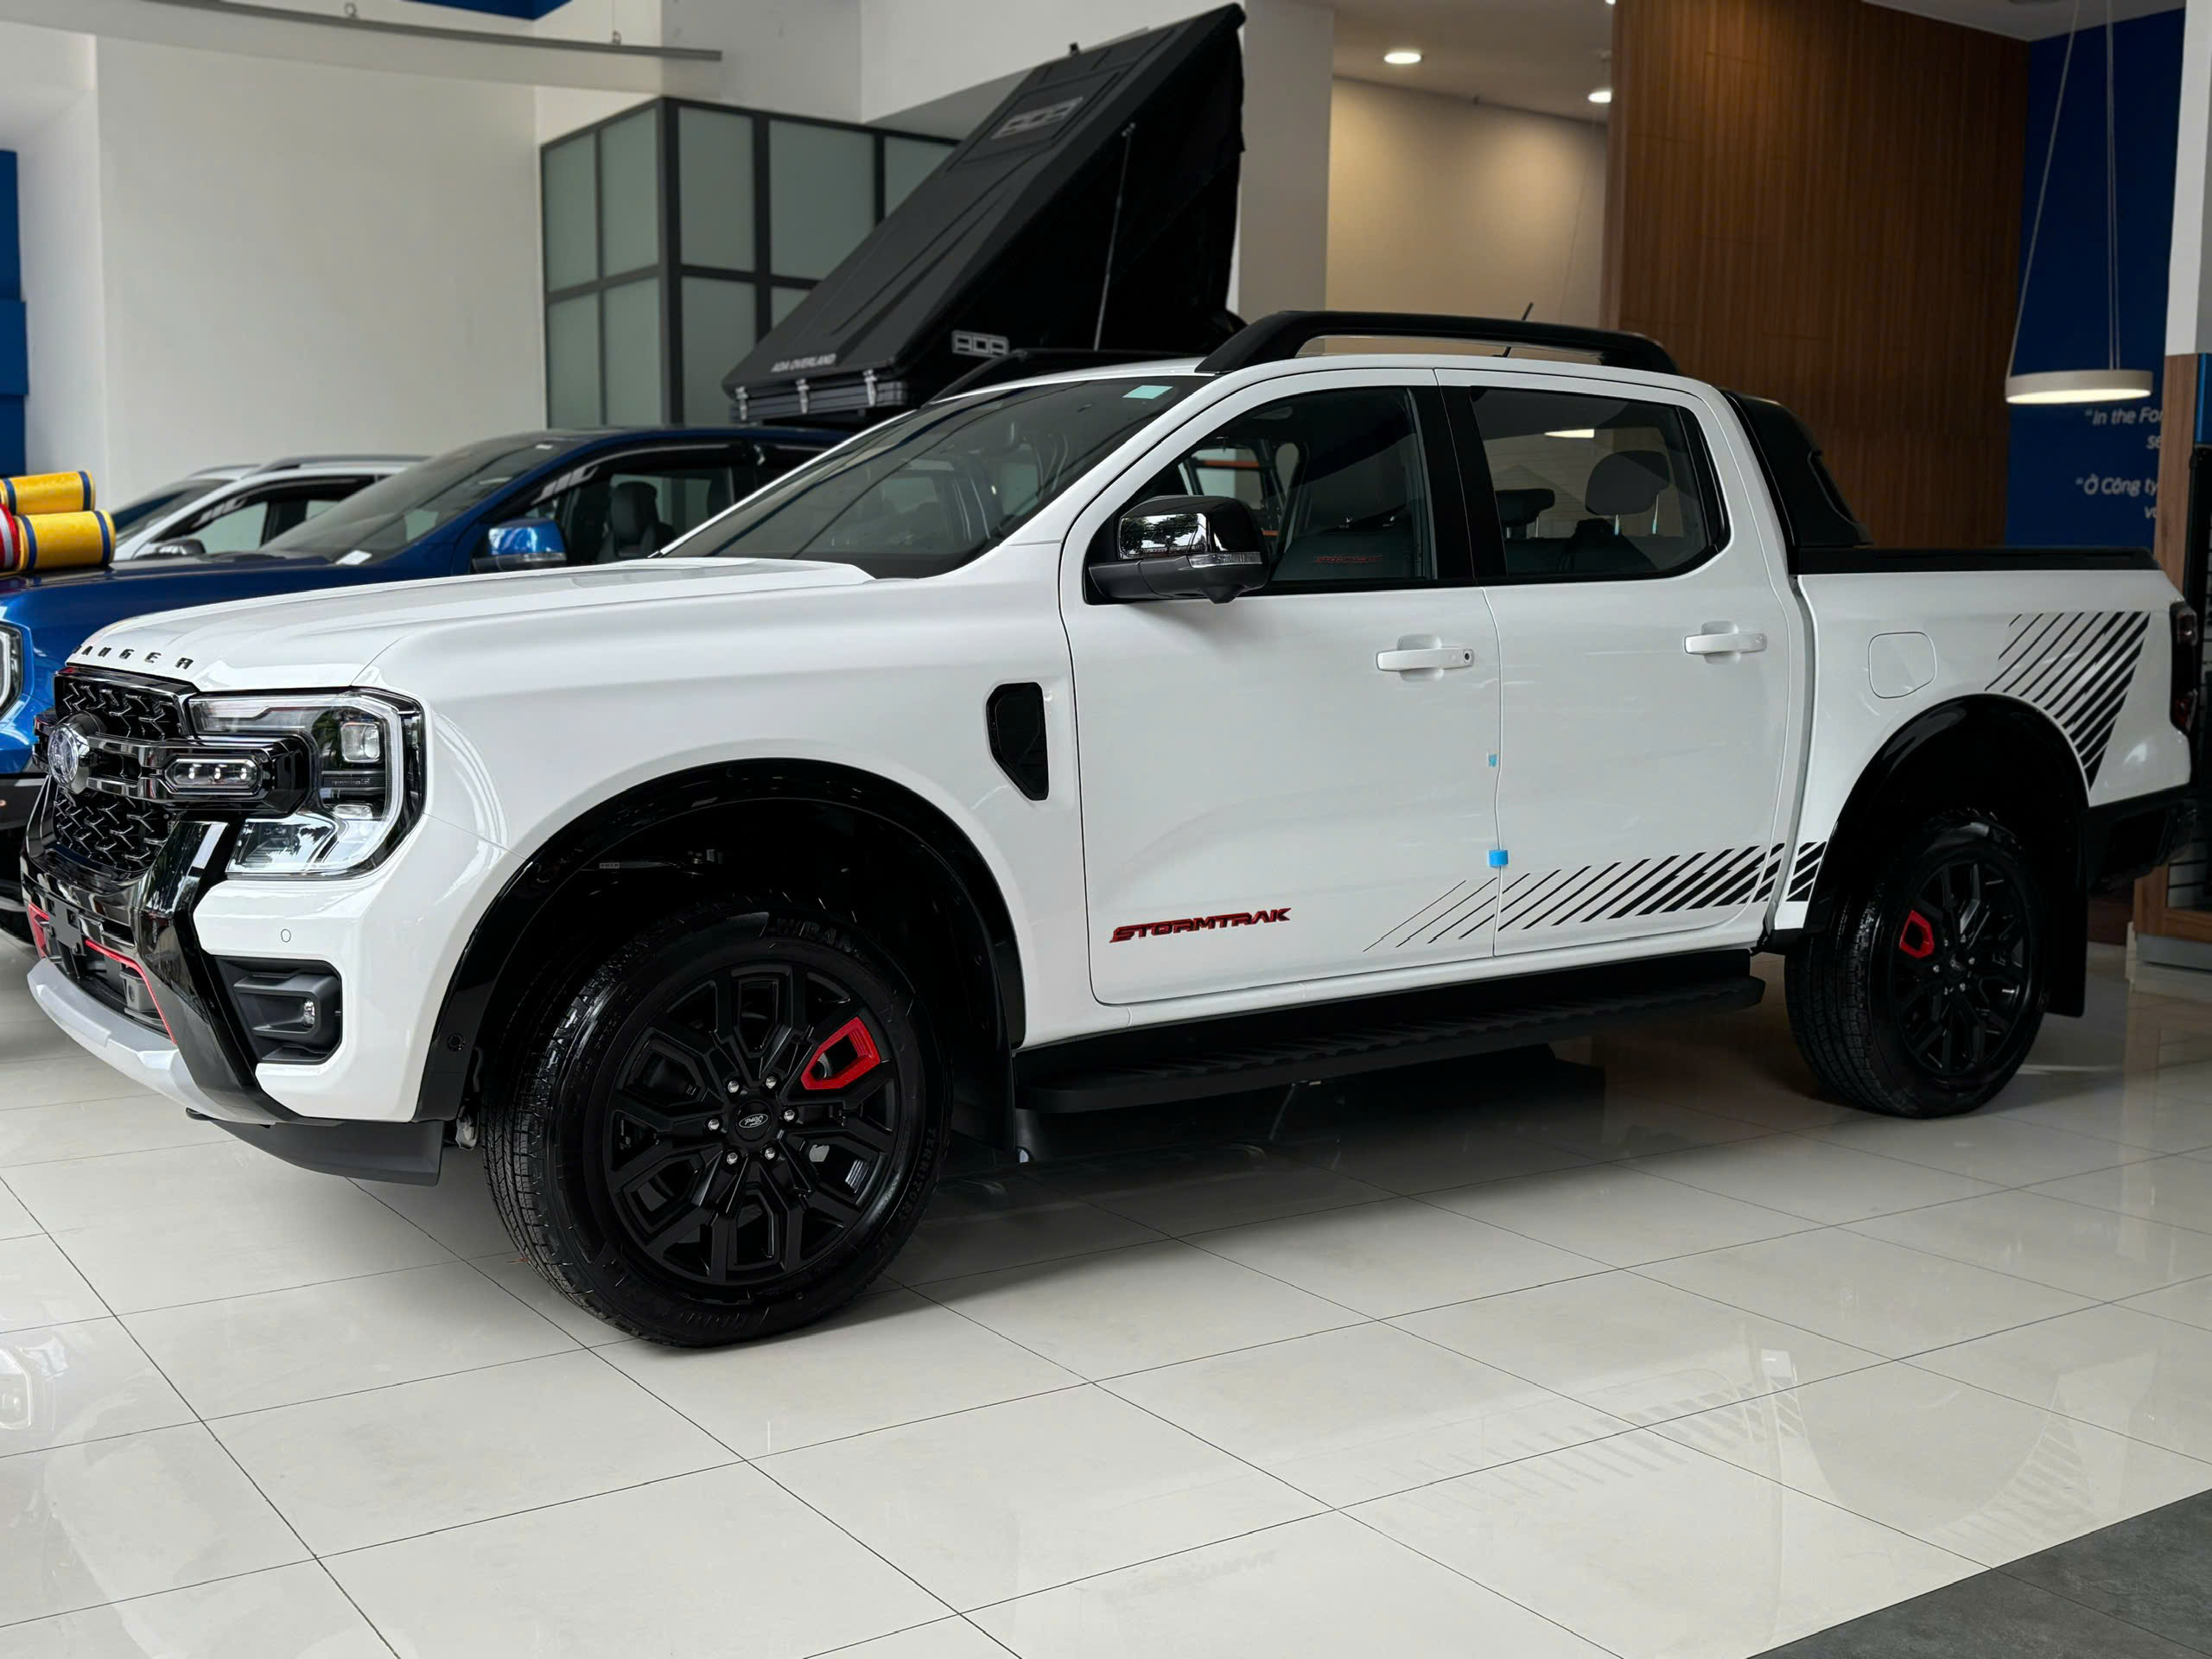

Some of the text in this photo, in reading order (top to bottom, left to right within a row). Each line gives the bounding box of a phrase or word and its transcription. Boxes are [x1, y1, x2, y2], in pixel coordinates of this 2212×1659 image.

[2111, 408, 2136, 425] the
[2101, 476, 2141, 497] Công
[1109, 907, 1291, 944] STORMTRAK
